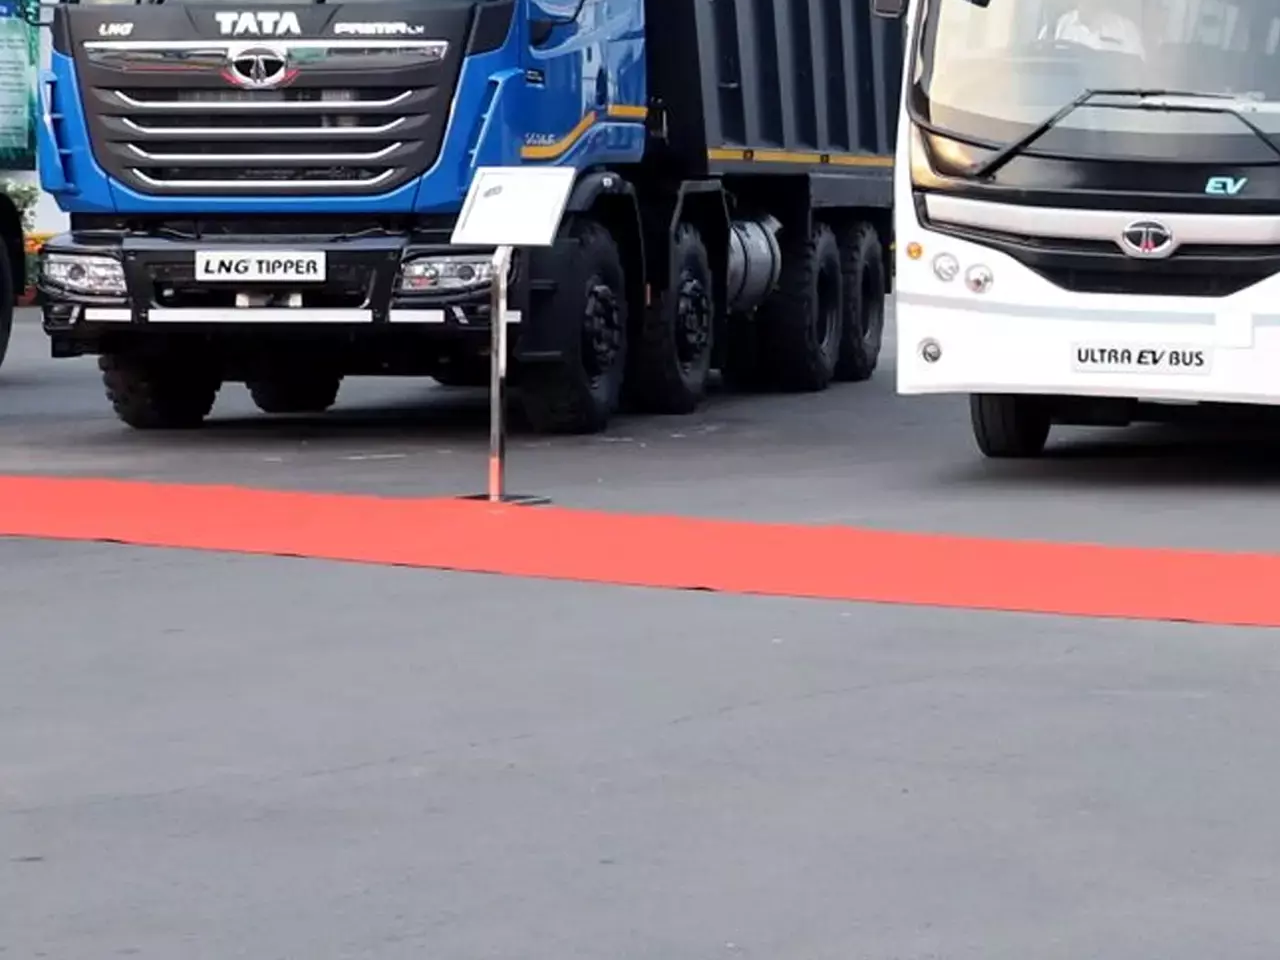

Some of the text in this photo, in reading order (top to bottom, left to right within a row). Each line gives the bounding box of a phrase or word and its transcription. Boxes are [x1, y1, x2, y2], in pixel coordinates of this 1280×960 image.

[215, 11, 302, 36] TATA
[1205, 176, 1248, 195] EV
[204, 259, 318, 275] LNG TIPPER
[1077, 348, 1204, 367] ULTRA EV BUS
